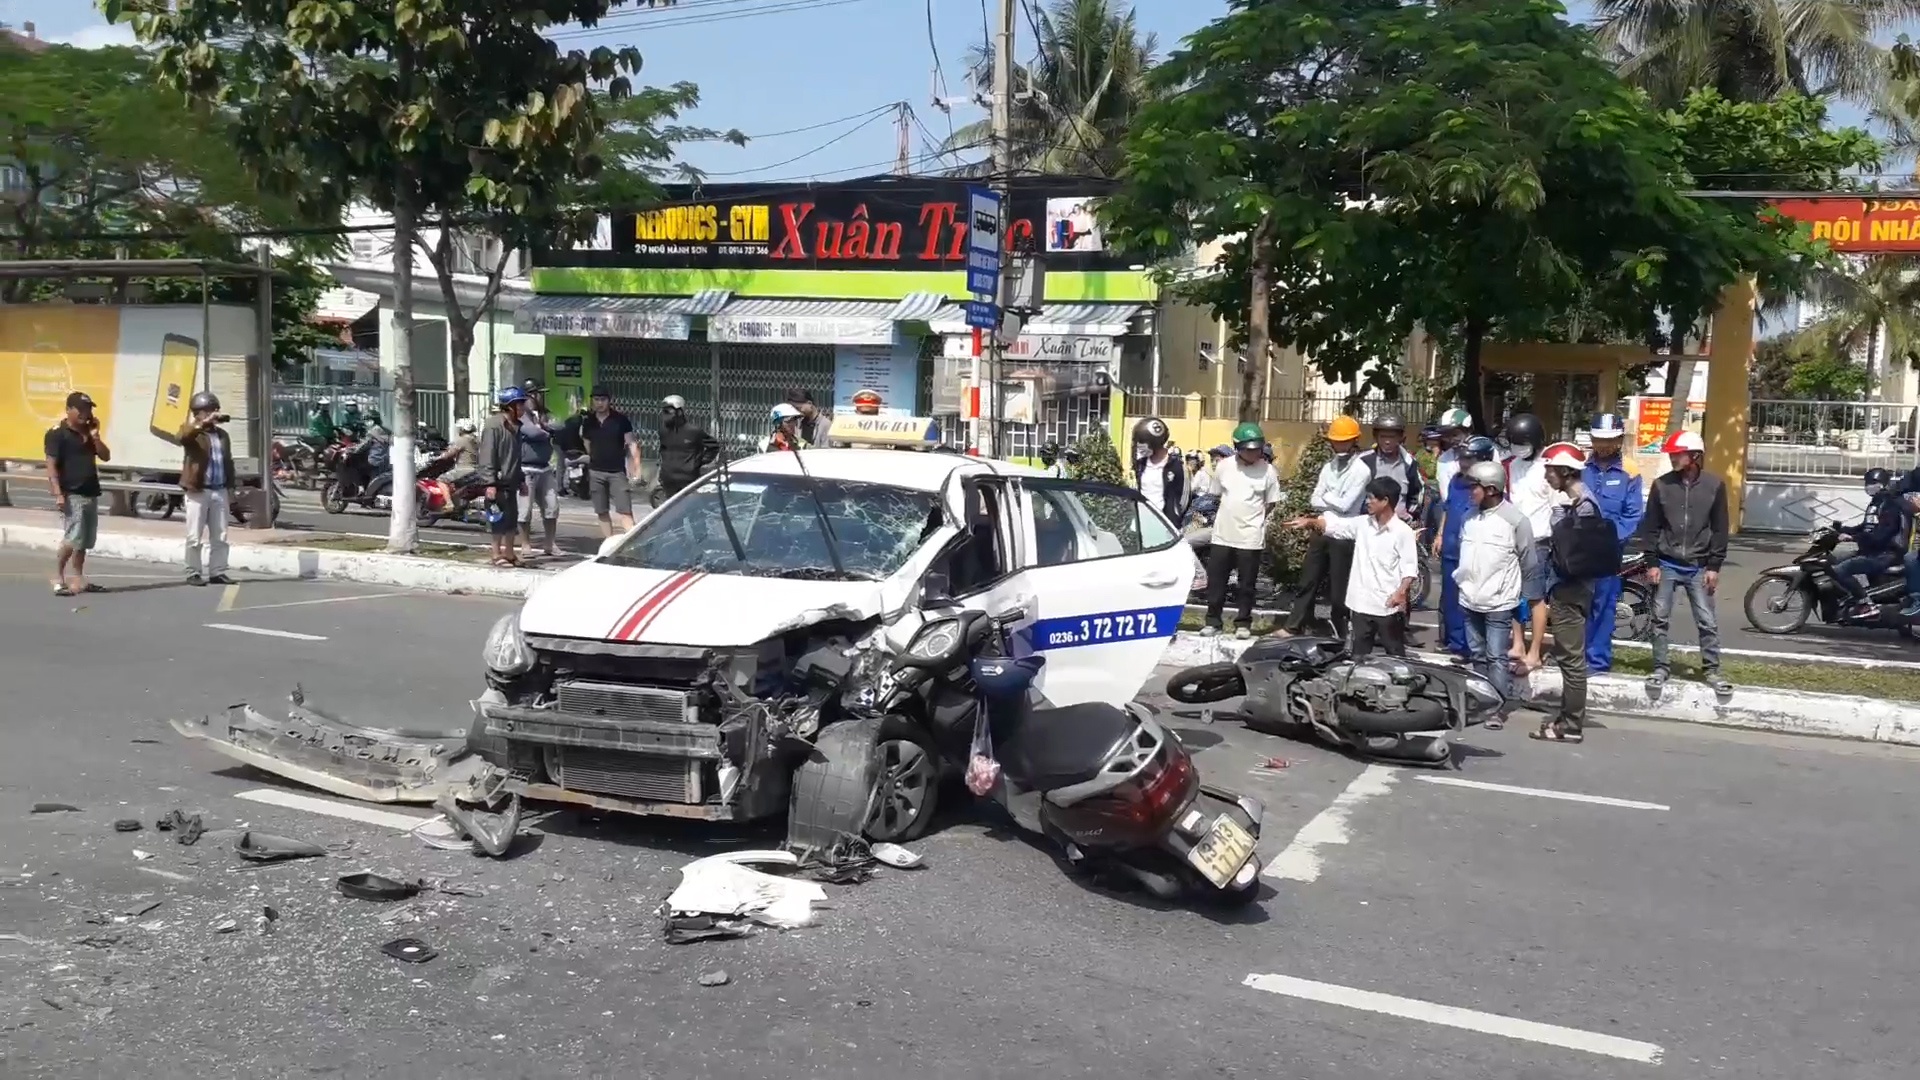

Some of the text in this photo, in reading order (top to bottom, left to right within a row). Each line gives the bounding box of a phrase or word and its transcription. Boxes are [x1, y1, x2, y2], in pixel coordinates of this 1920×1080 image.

[635, 205, 718, 241] AEROBICS
[730, 204, 770, 241] GYM
[770, 203, 1034, 260] Xuân Trc
[1813, 215, 1862, 246] ĐỘI
[634, 243, 648, 255] 29
[738, 321, 773, 337] AEROBICS
[780, 322, 797, 338] GYM
[1034, 336, 1073, 358] Xuân
[1075, 337, 1110, 358] Trúc
[1093, 617, 1113, 639] 72
[1115, 615, 1135, 637] 72
[1138, 613, 1157, 634] 72
